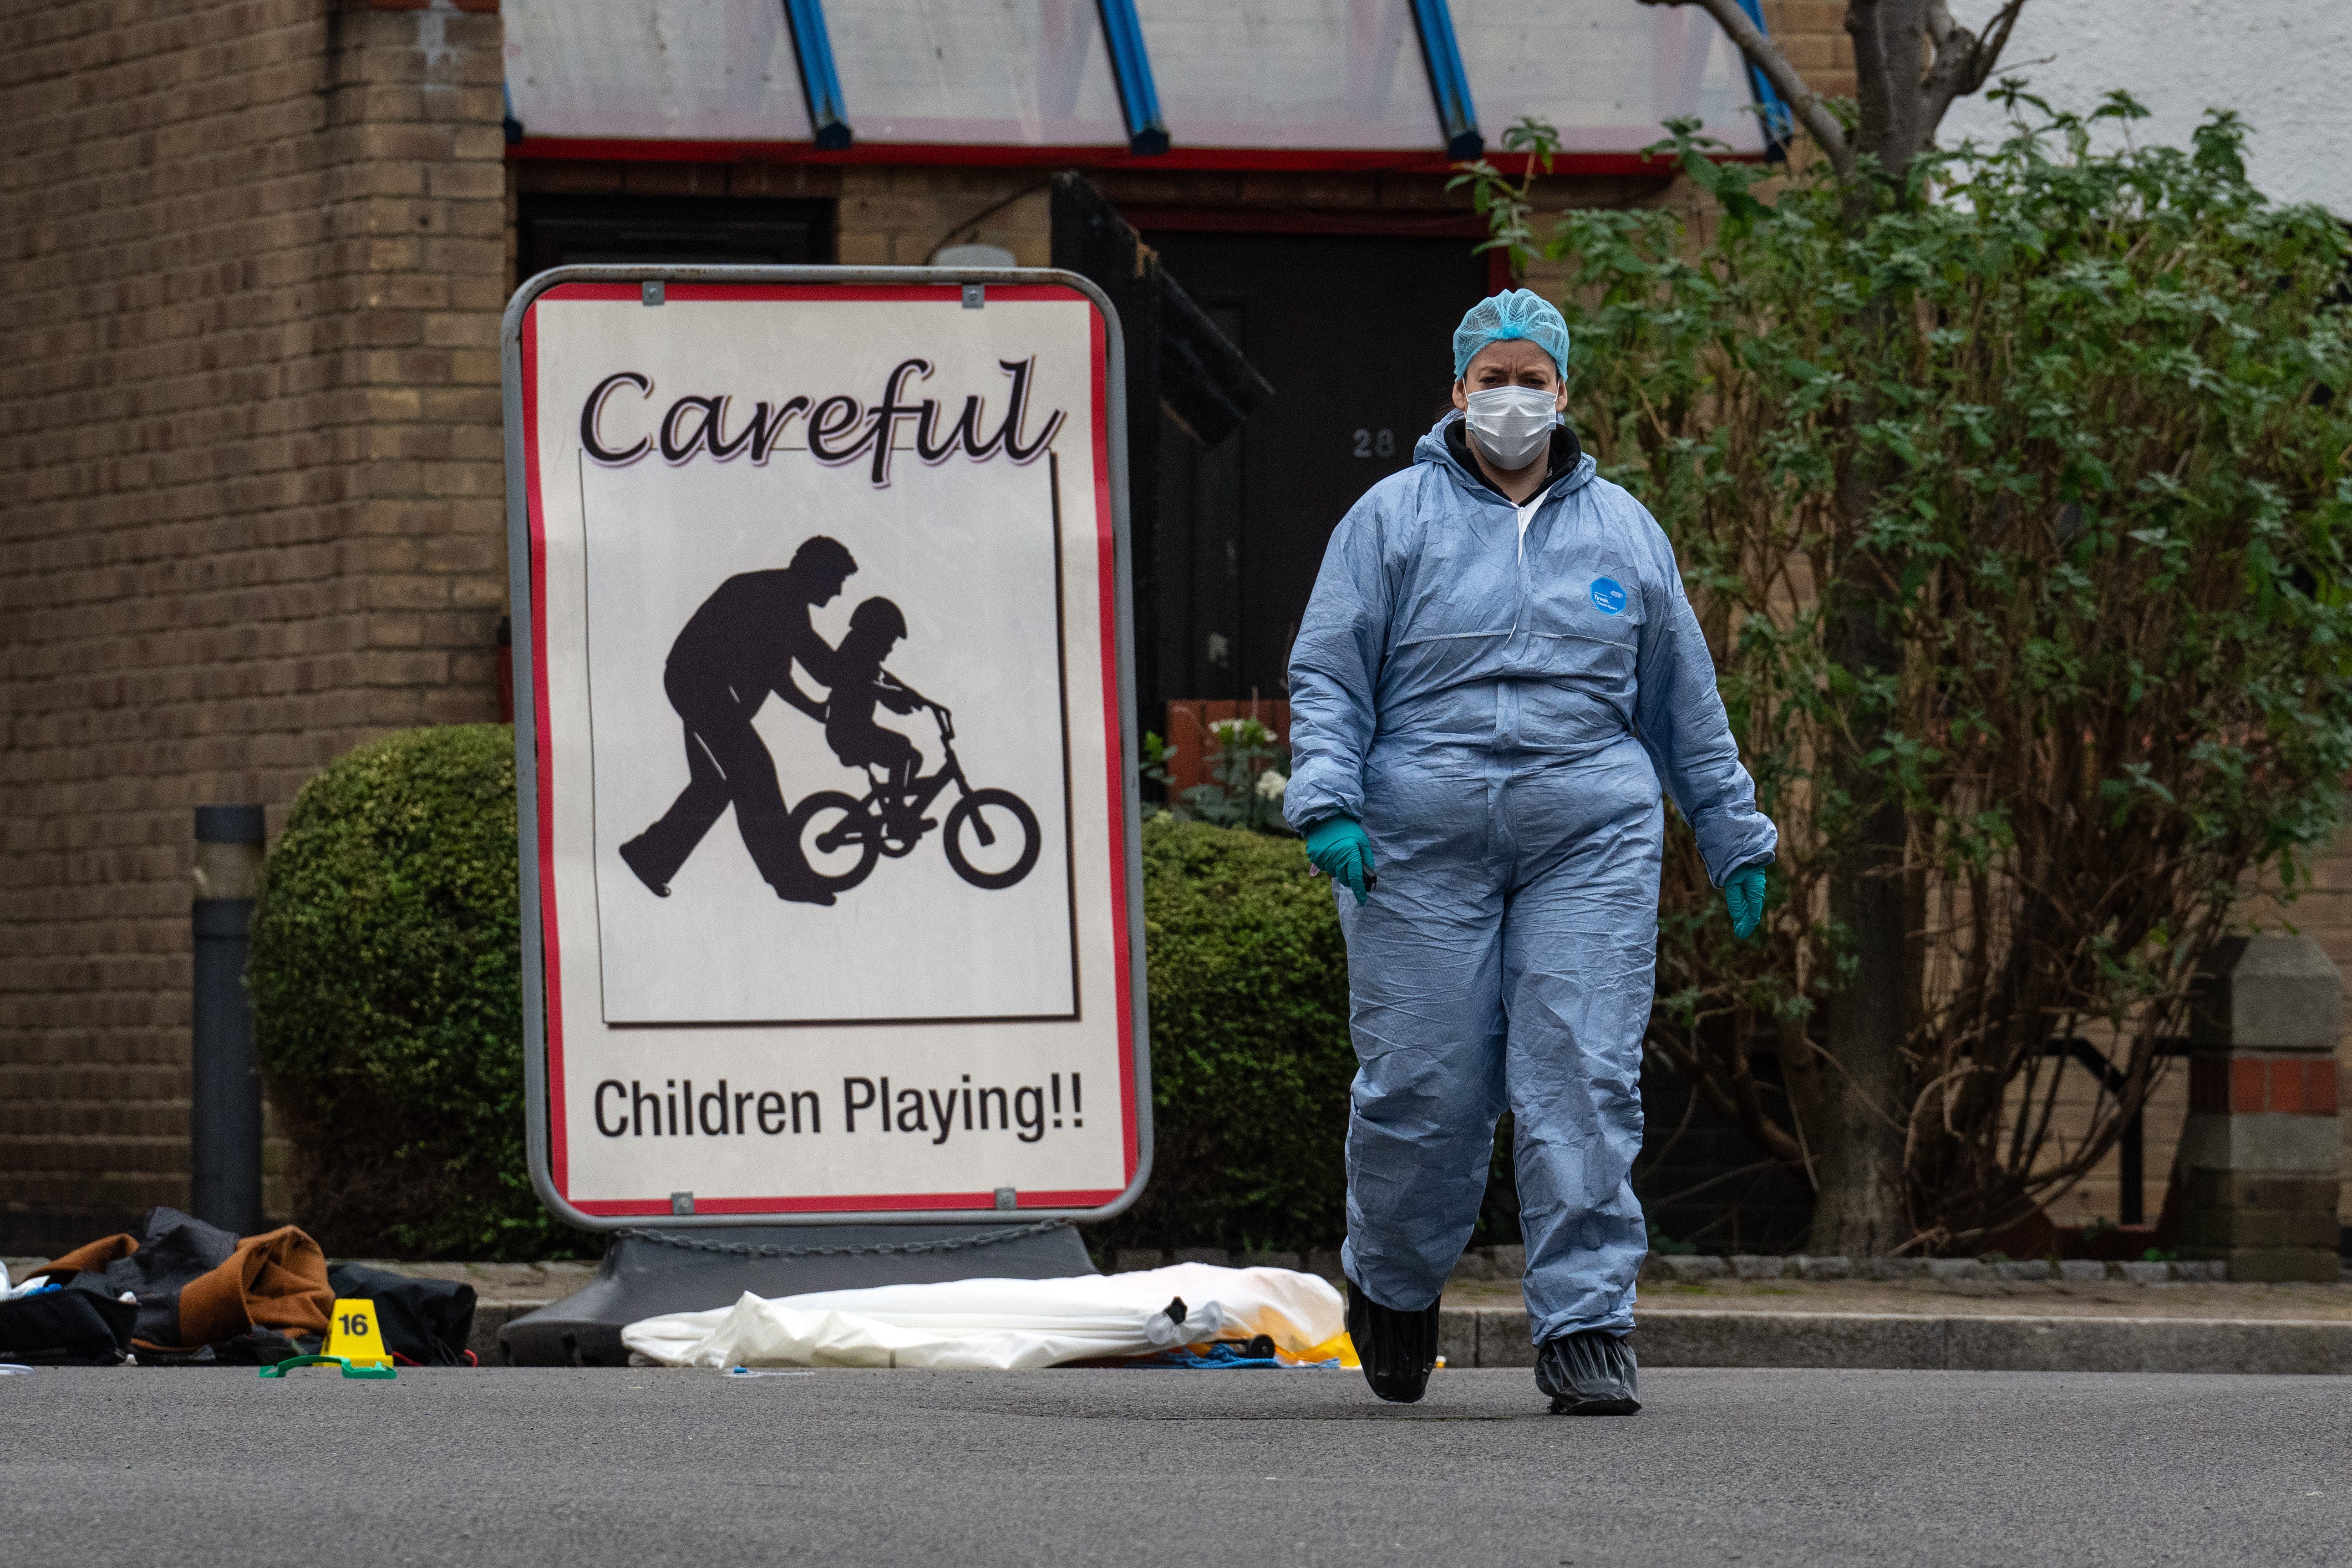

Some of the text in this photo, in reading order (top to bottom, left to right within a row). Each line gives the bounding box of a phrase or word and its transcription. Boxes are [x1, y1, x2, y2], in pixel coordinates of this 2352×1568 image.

[579, 355, 1067, 490] Careful
[1353, 429, 1394, 457] 28
[594, 1072, 1083, 1145] Children Playing!!
[338, 1314, 368, 1336] 16
